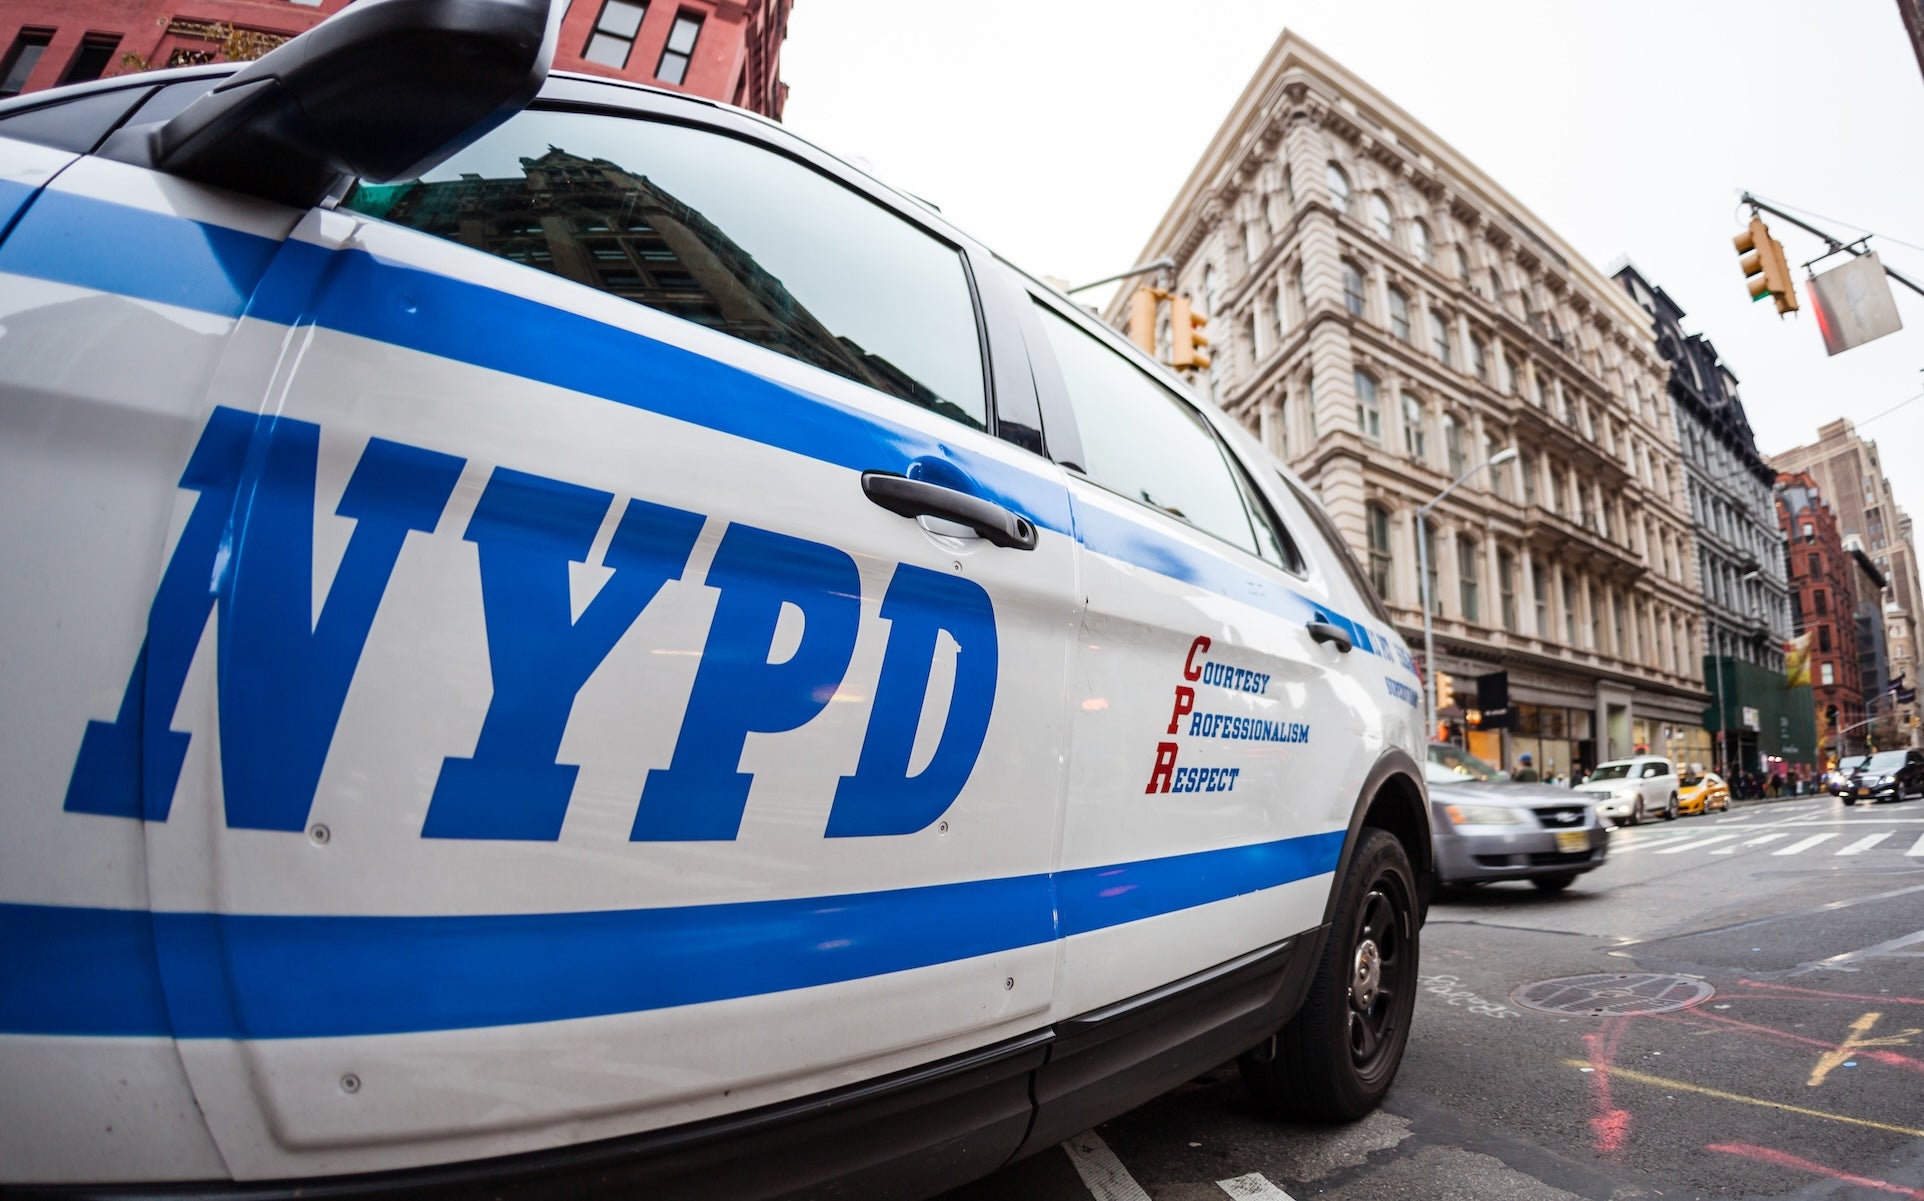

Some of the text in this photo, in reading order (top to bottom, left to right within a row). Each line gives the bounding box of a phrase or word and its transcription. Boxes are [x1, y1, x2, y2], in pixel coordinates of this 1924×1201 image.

[63, 405, 998, 842] NYPD
[1183, 635, 1270, 694] COURTESY
[1167, 684, 1310, 743] PROFESSIONALISM
[1145, 742, 1240, 794] RESPECT
